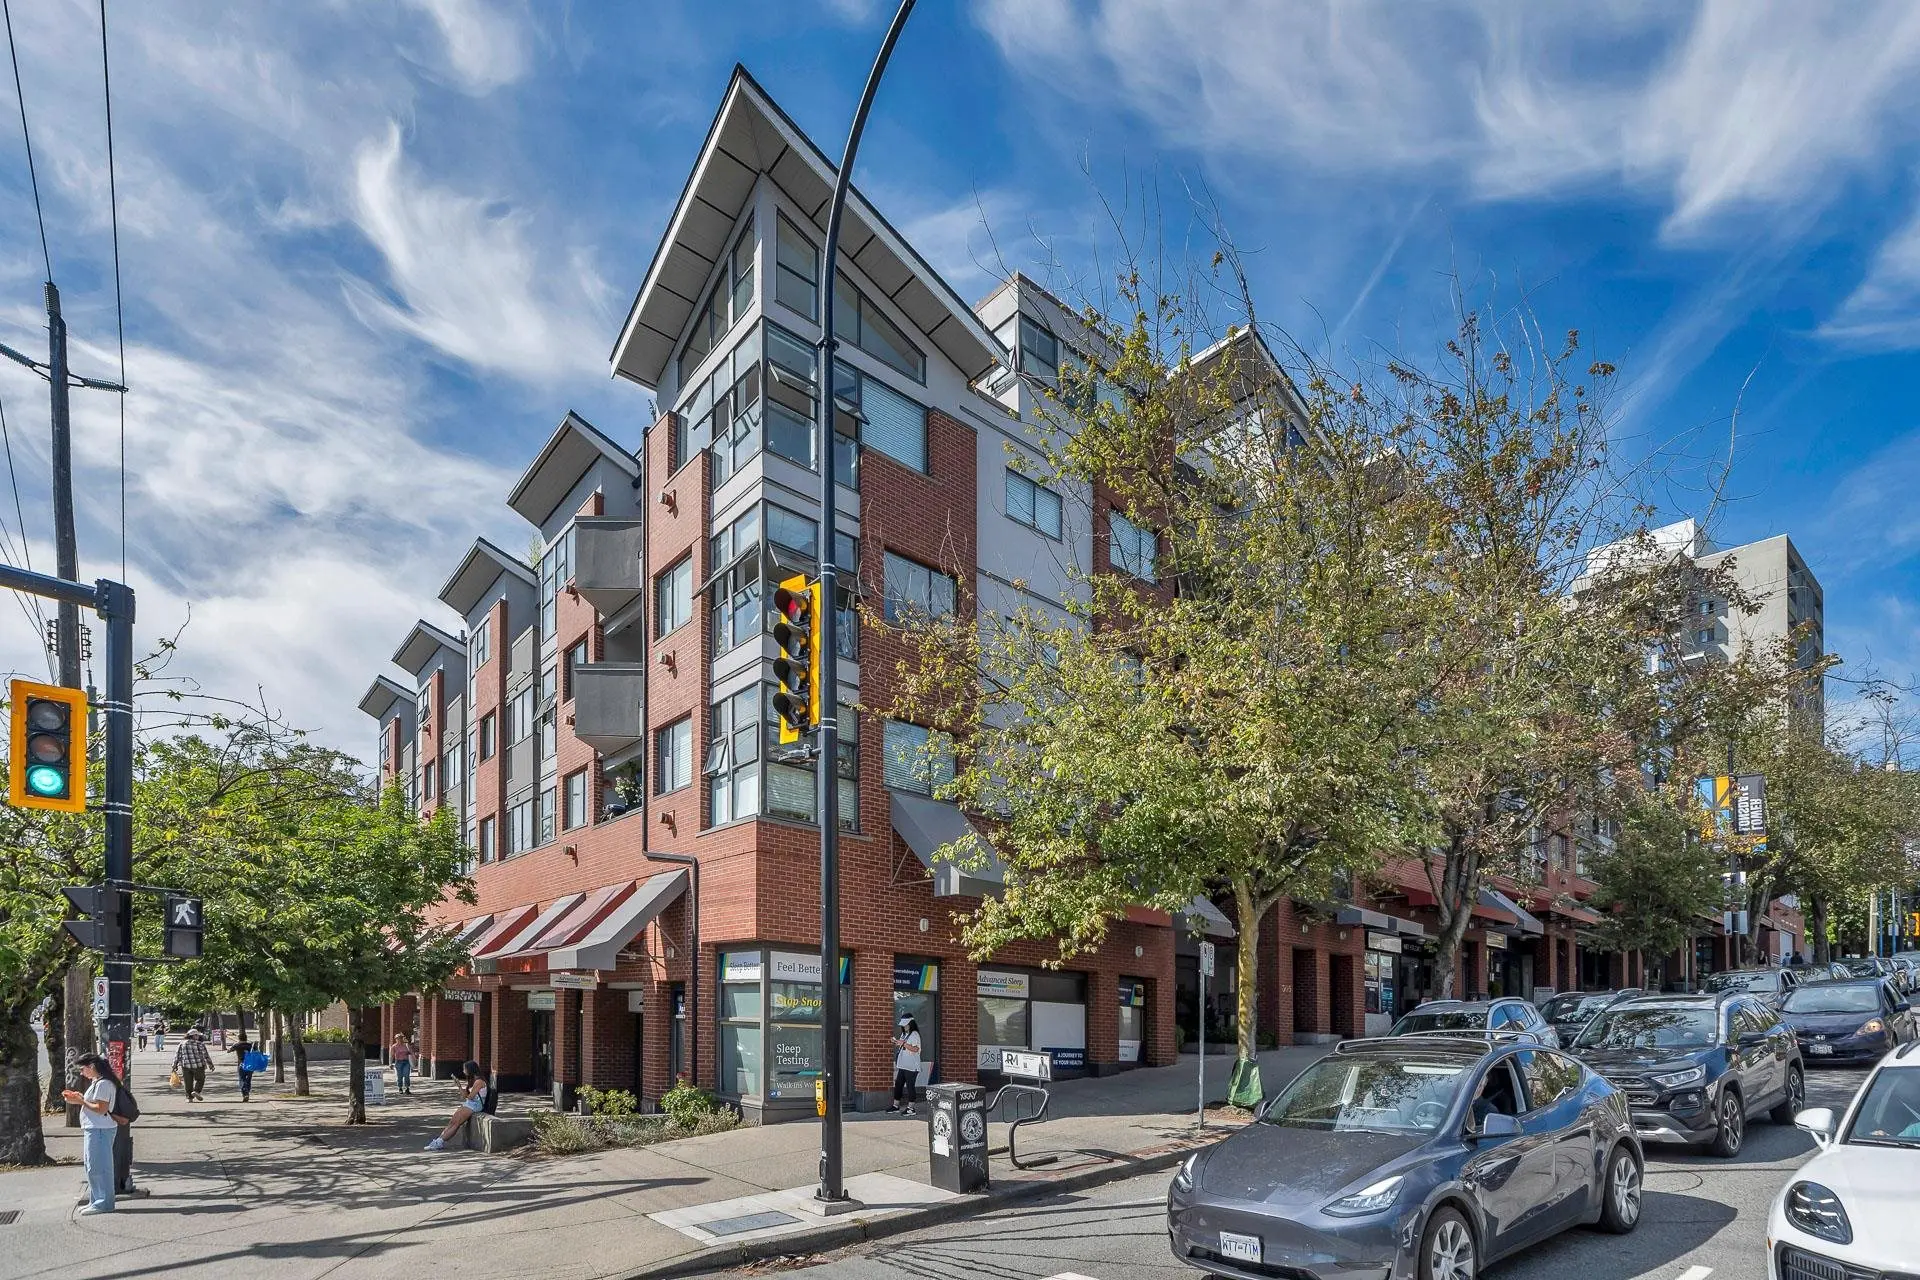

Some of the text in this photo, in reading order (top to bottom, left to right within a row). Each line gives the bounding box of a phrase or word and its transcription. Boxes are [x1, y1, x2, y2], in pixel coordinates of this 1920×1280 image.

[777, 961, 823, 975] Feel Bette
[978, 974, 1024, 987] Advanced Sleep
[776, 995, 799, 1009] Stop
[776, 1043, 801, 1057] Sleep
[776, 1054, 810, 1068] Testing
